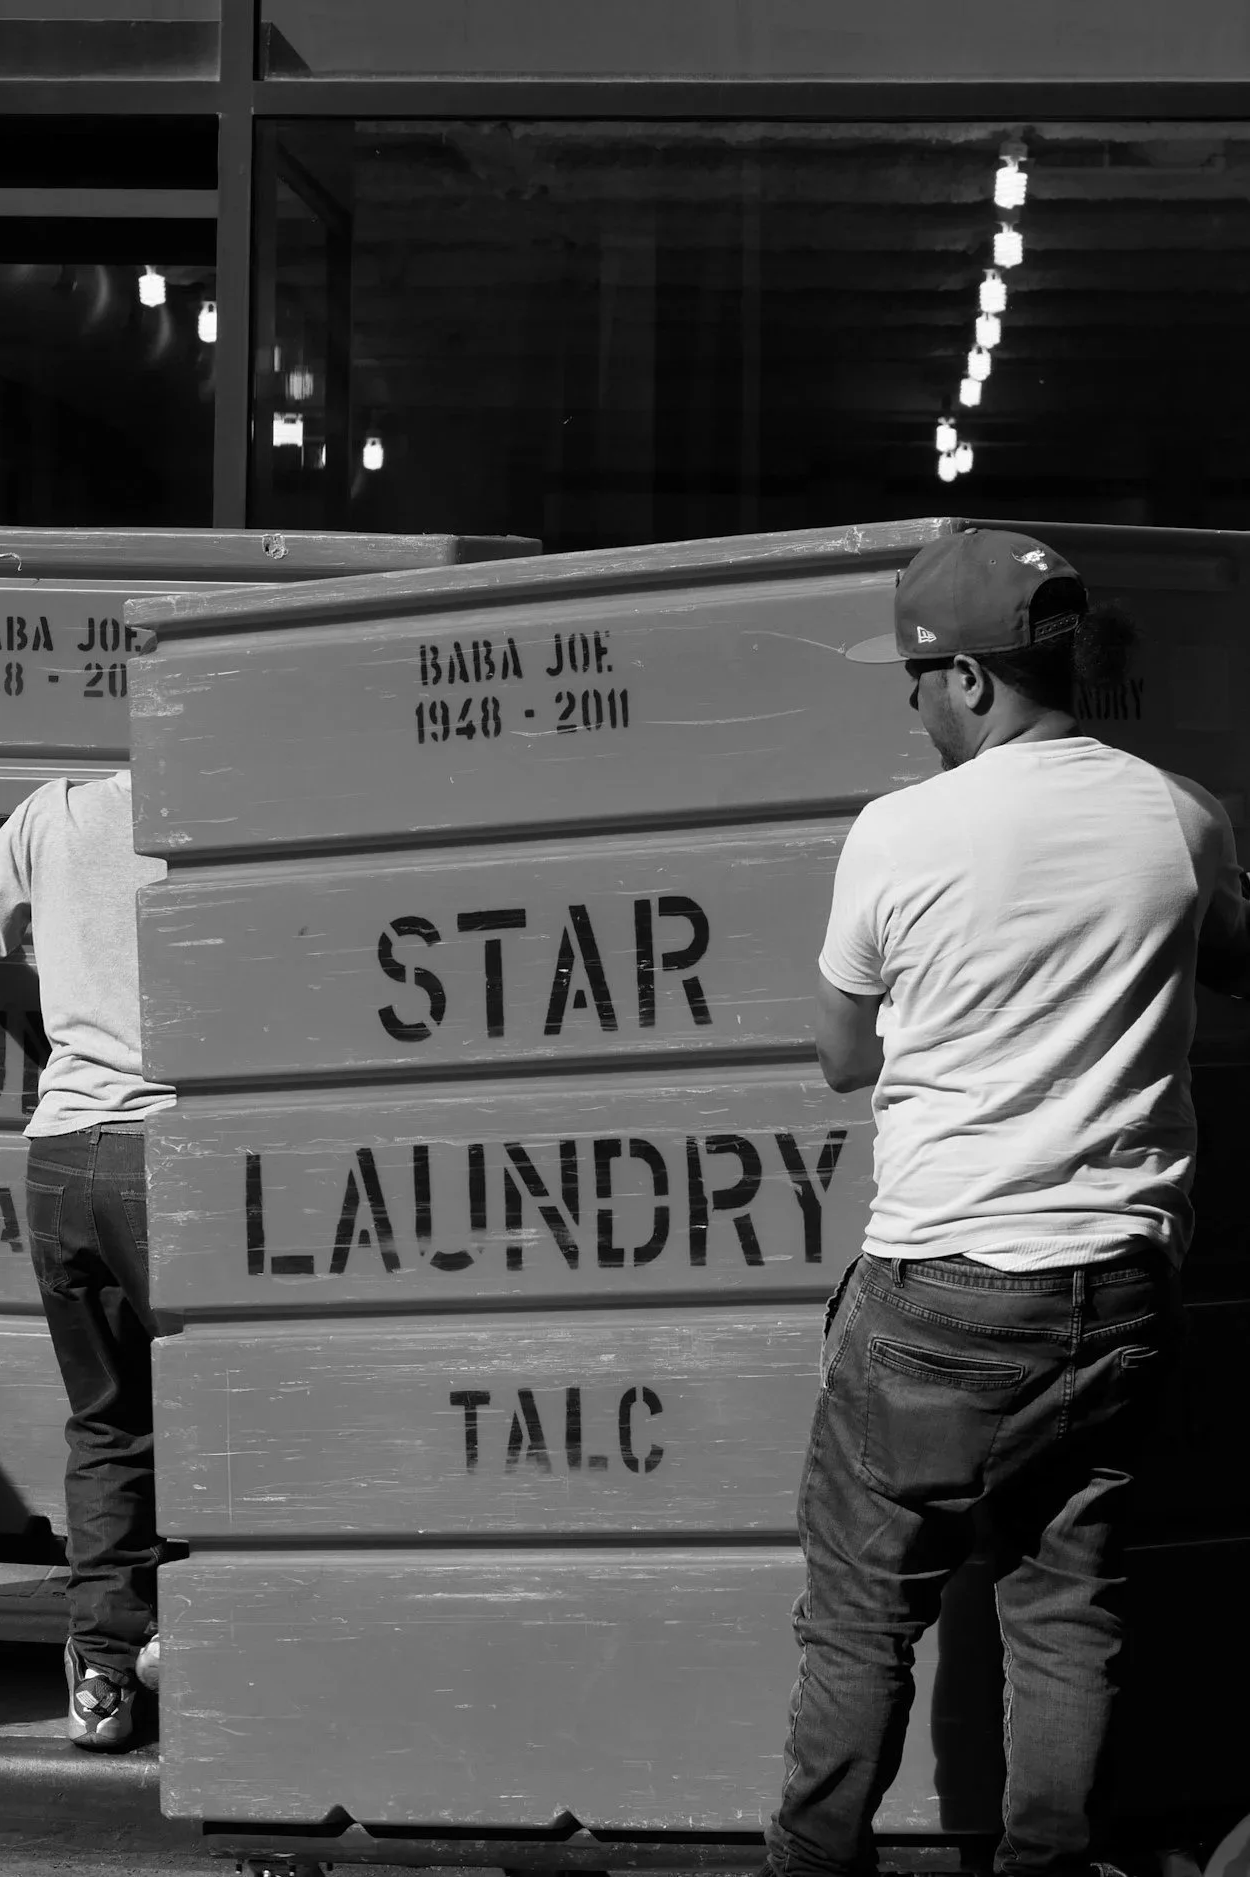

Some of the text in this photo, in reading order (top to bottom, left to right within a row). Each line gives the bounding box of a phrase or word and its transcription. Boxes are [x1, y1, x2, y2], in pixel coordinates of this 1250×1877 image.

[419, 630, 610, 685] BABA JOE
[415, 697, 501, 744] 1948
[556, 688, 629, 734] 2011
[377, 896, 712, 1043] STAR
[245, 1130, 848, 1276] LAUNDRY
[450, 1386, 664, 1474] TALC
